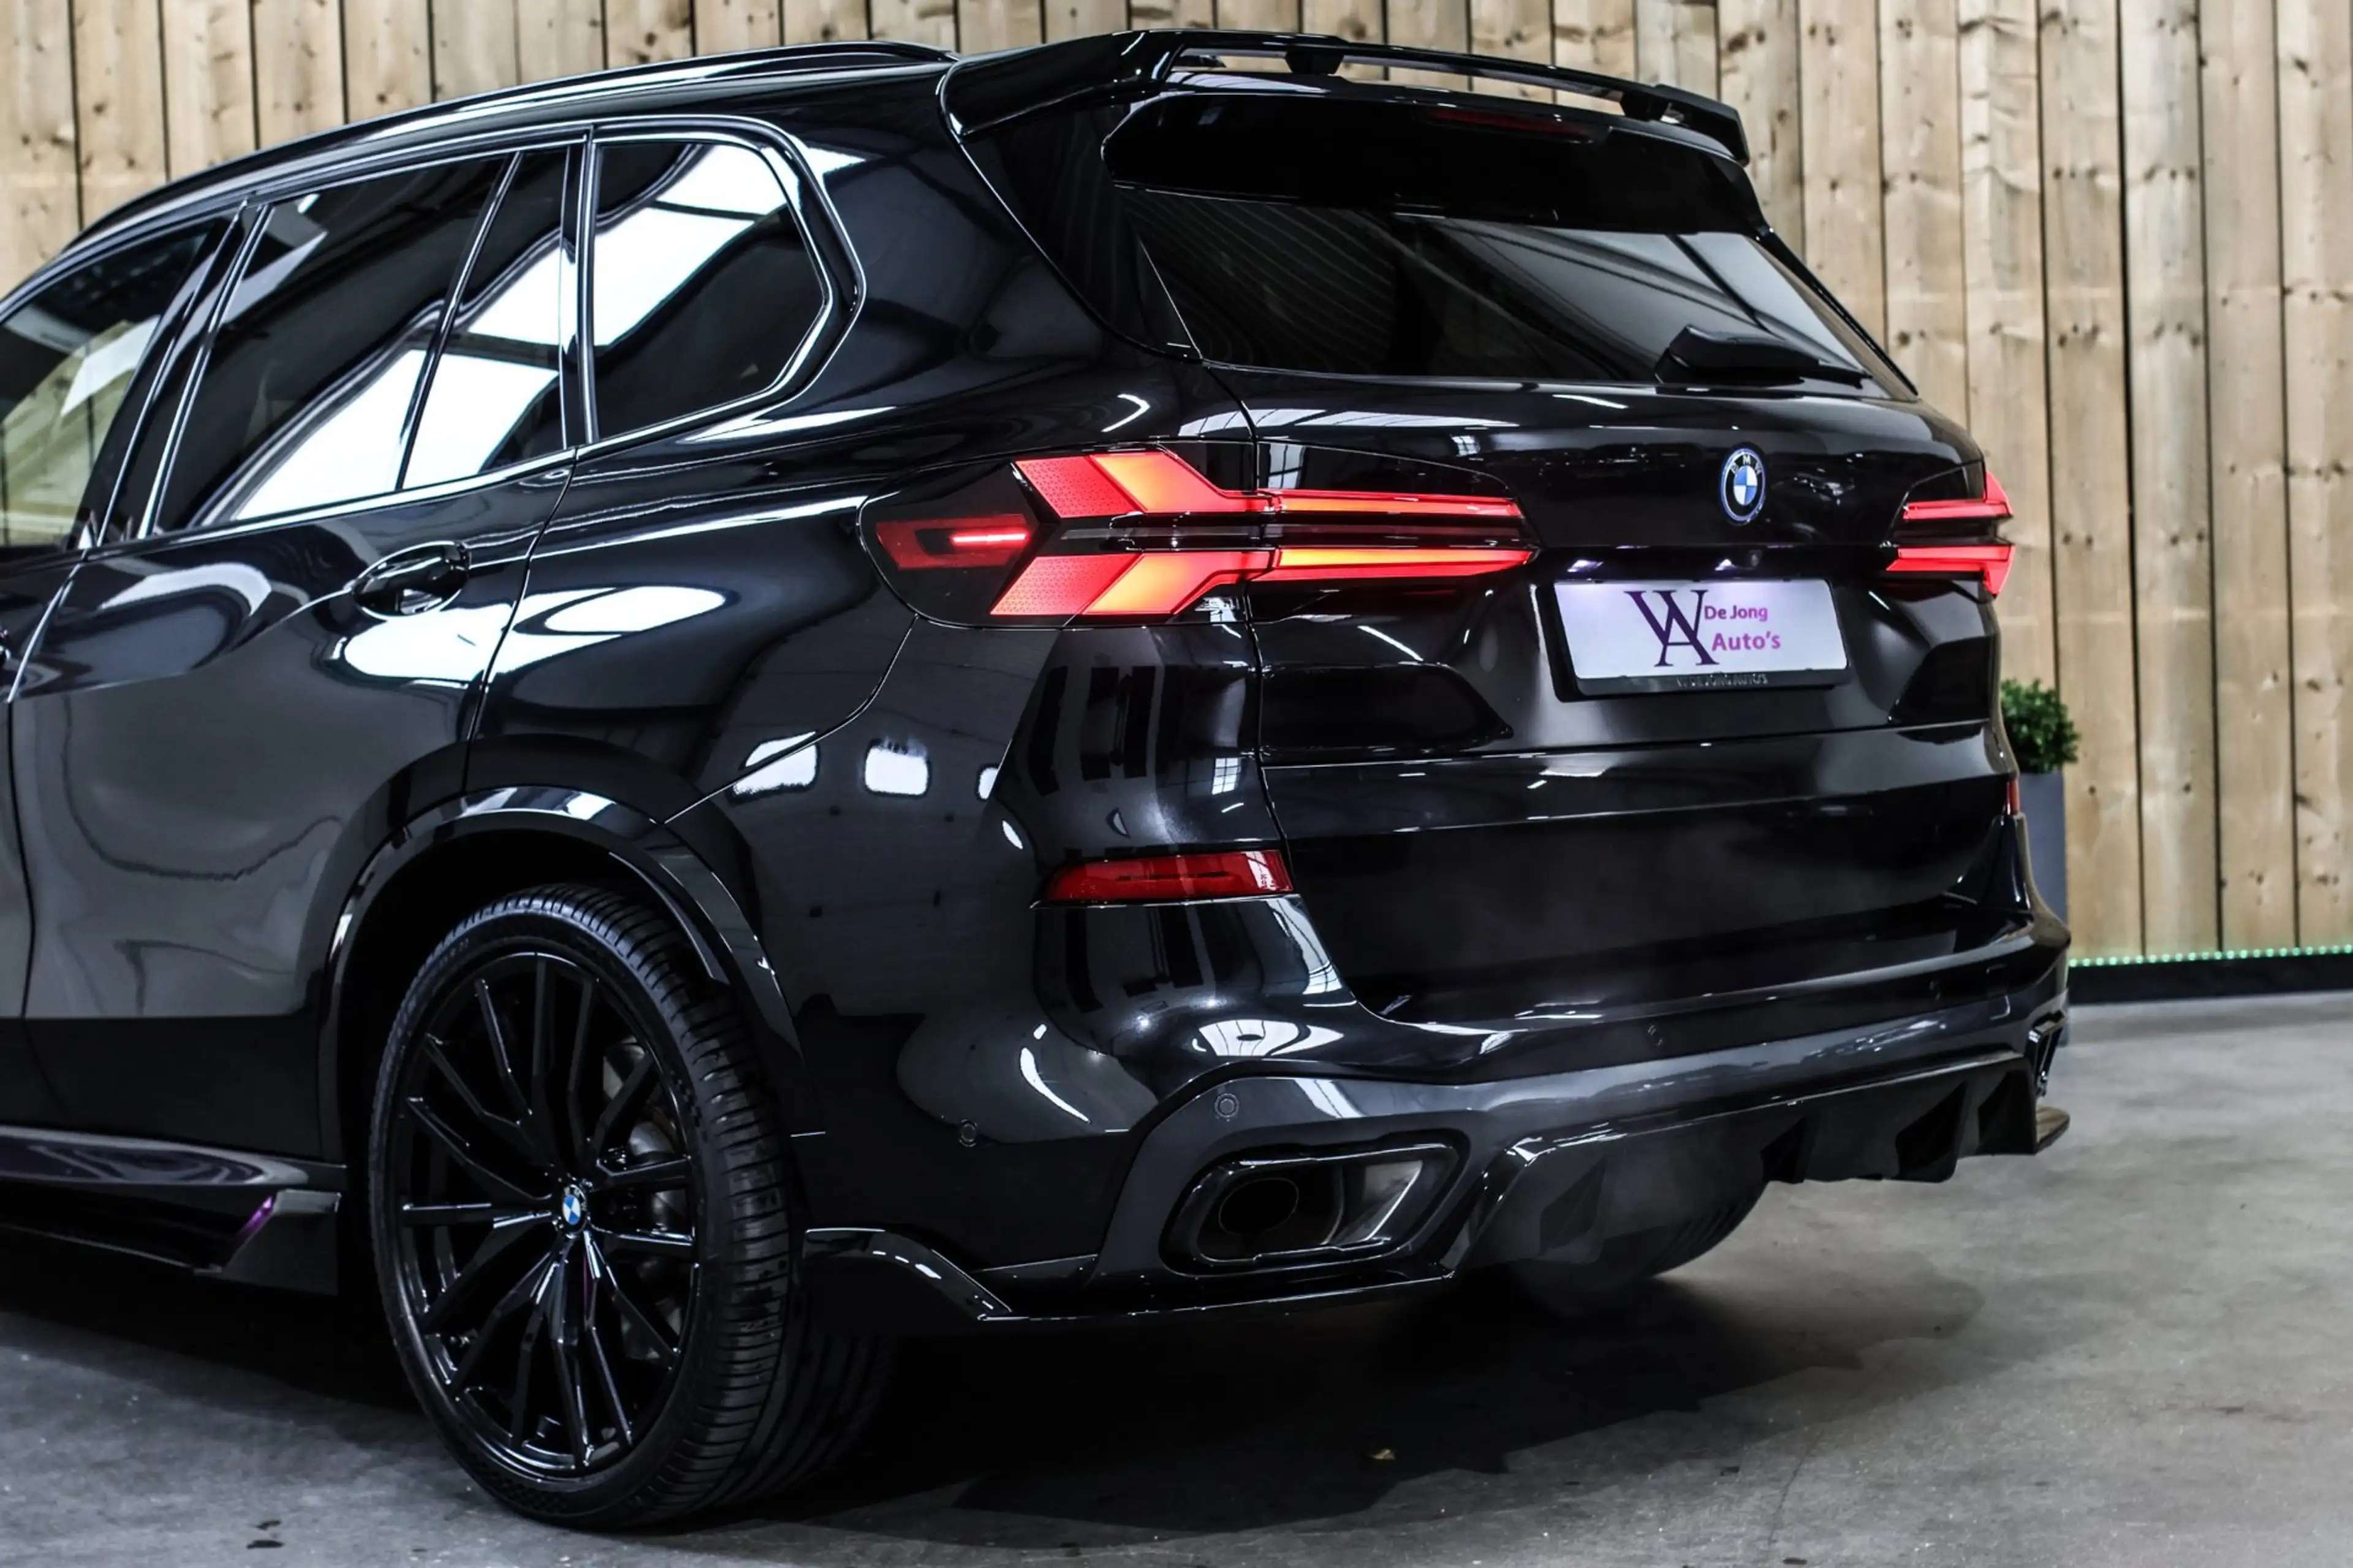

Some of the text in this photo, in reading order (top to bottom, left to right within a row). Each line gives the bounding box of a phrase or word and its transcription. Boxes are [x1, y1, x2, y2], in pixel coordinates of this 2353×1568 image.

[1704, 605, 1768, 622] De Jong
[1711, 631, 1781, 652] Auto's
